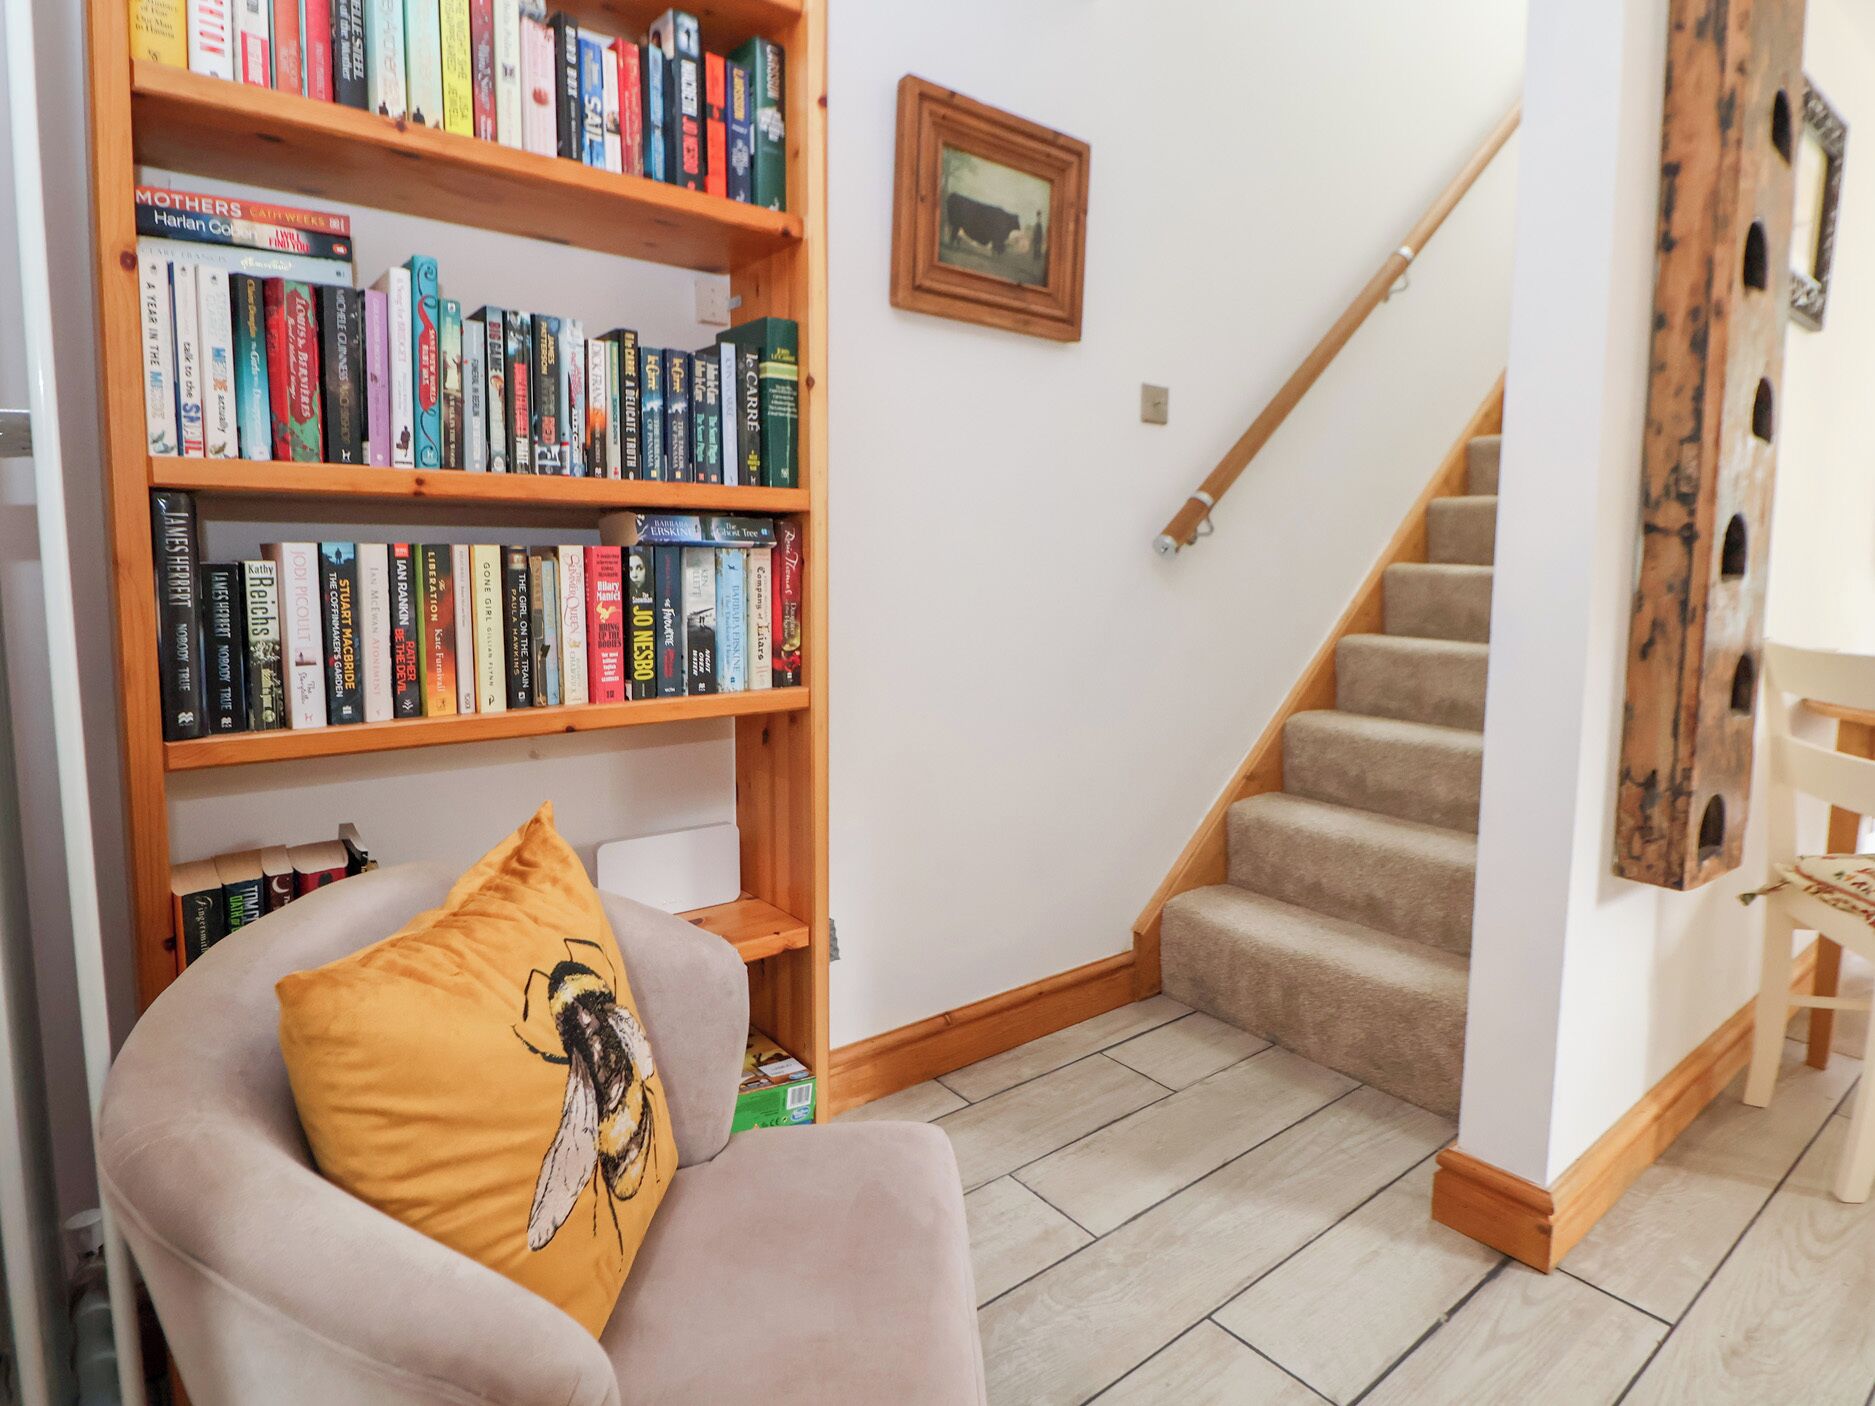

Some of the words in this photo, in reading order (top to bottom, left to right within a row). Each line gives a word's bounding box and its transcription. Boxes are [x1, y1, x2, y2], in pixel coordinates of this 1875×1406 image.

[584, 94, 602, 145] SAIL
[136, 189, 242, 218] MOTHERS
[154, 209, 206, 232] Harlan
[147, 294, 159, 323] YEAR
[150, 328, 159, 341] IN
[540, 320, 548, 375] PATTERSON
[150, 345, 161, 367] THE
[183, 341, 194, 363] talk
[547, 334, 555, 366] JAMES
[745, 352, 758, 368] le
[185, 365, 196, 377] to
[625, 379, 636, 389] A
[186, 380, 196, 399] the
[745, 370, 761, 433] CARRÉ
[625, 389, 638, 433] DELICATE
[647, 419, 654, 430] OF
[541, 415, 556, 445] RED
[671, 421, 679, 432] OF
[626, 437, 637, 468] TRUTH
[647, 431, 655, 468] PANAMA
[671, 433, 680, 470] PANAMA
[163, 511, 190, 552] JAMES
[650, 526, 695, 537] ERSKINE
[741, 528, 758, 538] Tree
[247, 563, 274, 576] Kathy
[291, 550, 307, 581] JODI
[396, 559, 408, 581] IAN
[483, 561, 493, 593] GONE
[165, 555, 192, 608] HERBERT
[211, 571, 230, 600] JAMES
[329, 572, 338, 589] THE
[428, 551, 439, 622] LIBERATION
[518, 573, 527, 593] THE
[597, 581, 619, 592] Hilary
[755, 566, 766, 610] Company
[249, 576, 277, 637] Reichs
[295, 586, 311, 642] PICOULT
[338, 578, 352, 626] STUART
[397, 582, 410, 626] RANKIN
[484, 598, 493, 623] GIRL
[518, 596, 528, 619] GIRL
[632, 604, 654, 627] JO
[212, 601, 232, 638] HERBERT
[330, 590, 342, 659] COFFINMAKER'S
[519, 621, 529, 636] ON
[175, 623, 189, 663] NOBODY
[394, 628, 405, 643] BE
[434, 628, 443, 650] Kate
[486, 627, 494, 659] GILLIAN
[520, 638, 529, 657] THE
[756, 622, 771, 661] Liars
[217, 644, 232, 682] NOBODY
[342, 628, 356, 690] MACBRIDE
[396, 644, 406, 660] THE
[406, 640, 417, 681] RATHER
[512, 628, 521, 676] HAWKINS
[633, 630, 655, 681] NESBO
[177, 666, 191, 692] TRUE
[333, 661, 344, 698] GARDEN
[396, 660, 407, 695] DEVIL
[435, 652, 446, 693] Furnivall
[521, 661, 530, 689] TRAIN
[219, 686, 233, 711] TRUE
[229, 895, 244, 919] OATH
[240, 884, 259, 910] TOM
